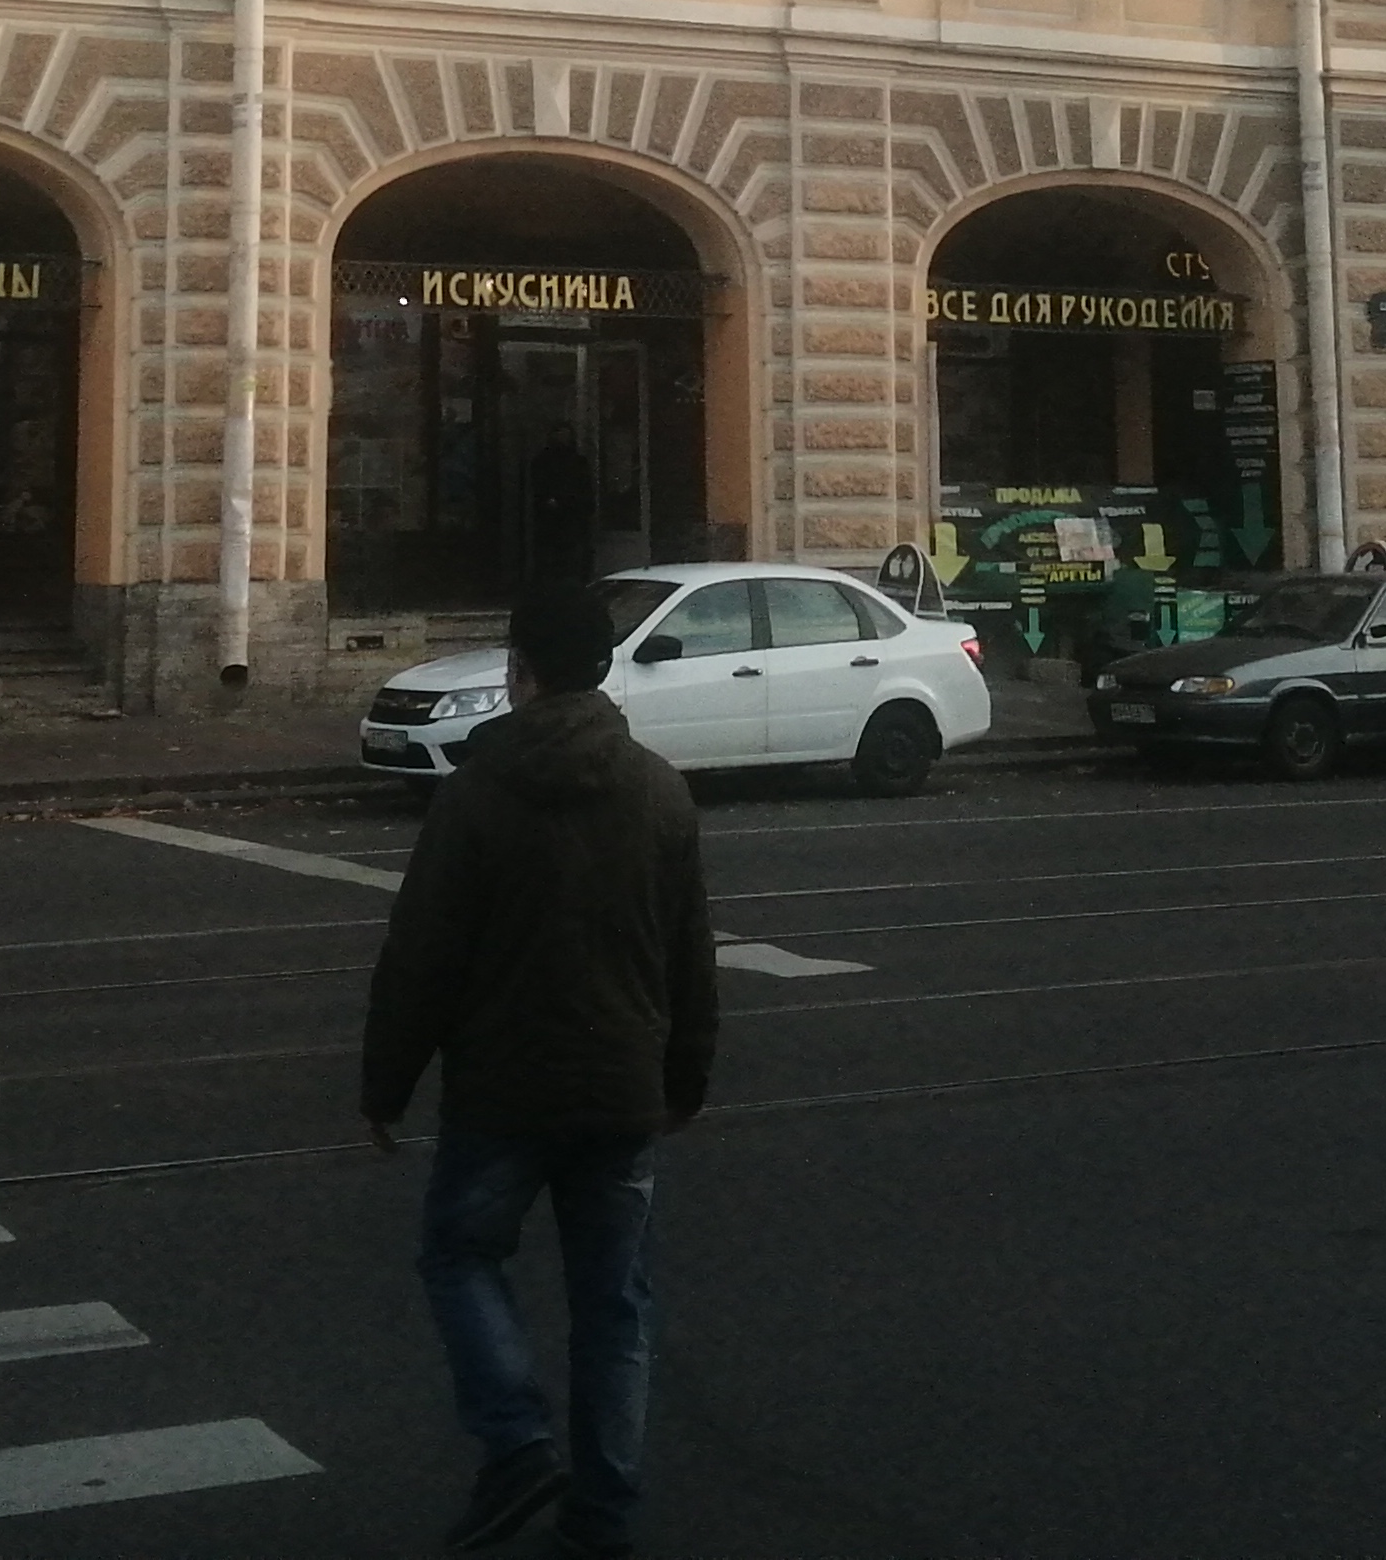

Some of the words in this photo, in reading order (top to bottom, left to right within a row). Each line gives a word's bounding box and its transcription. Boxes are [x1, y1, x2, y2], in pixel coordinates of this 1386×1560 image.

[422, 270, 635, 310] ИСКУСНИЦА
[925, 289, 979, 322] ВСЕ
[989, 292, 1053, 324] ДЛЯ
[1060, 294, 1234, 331] РУКОДЕЛИЯ
